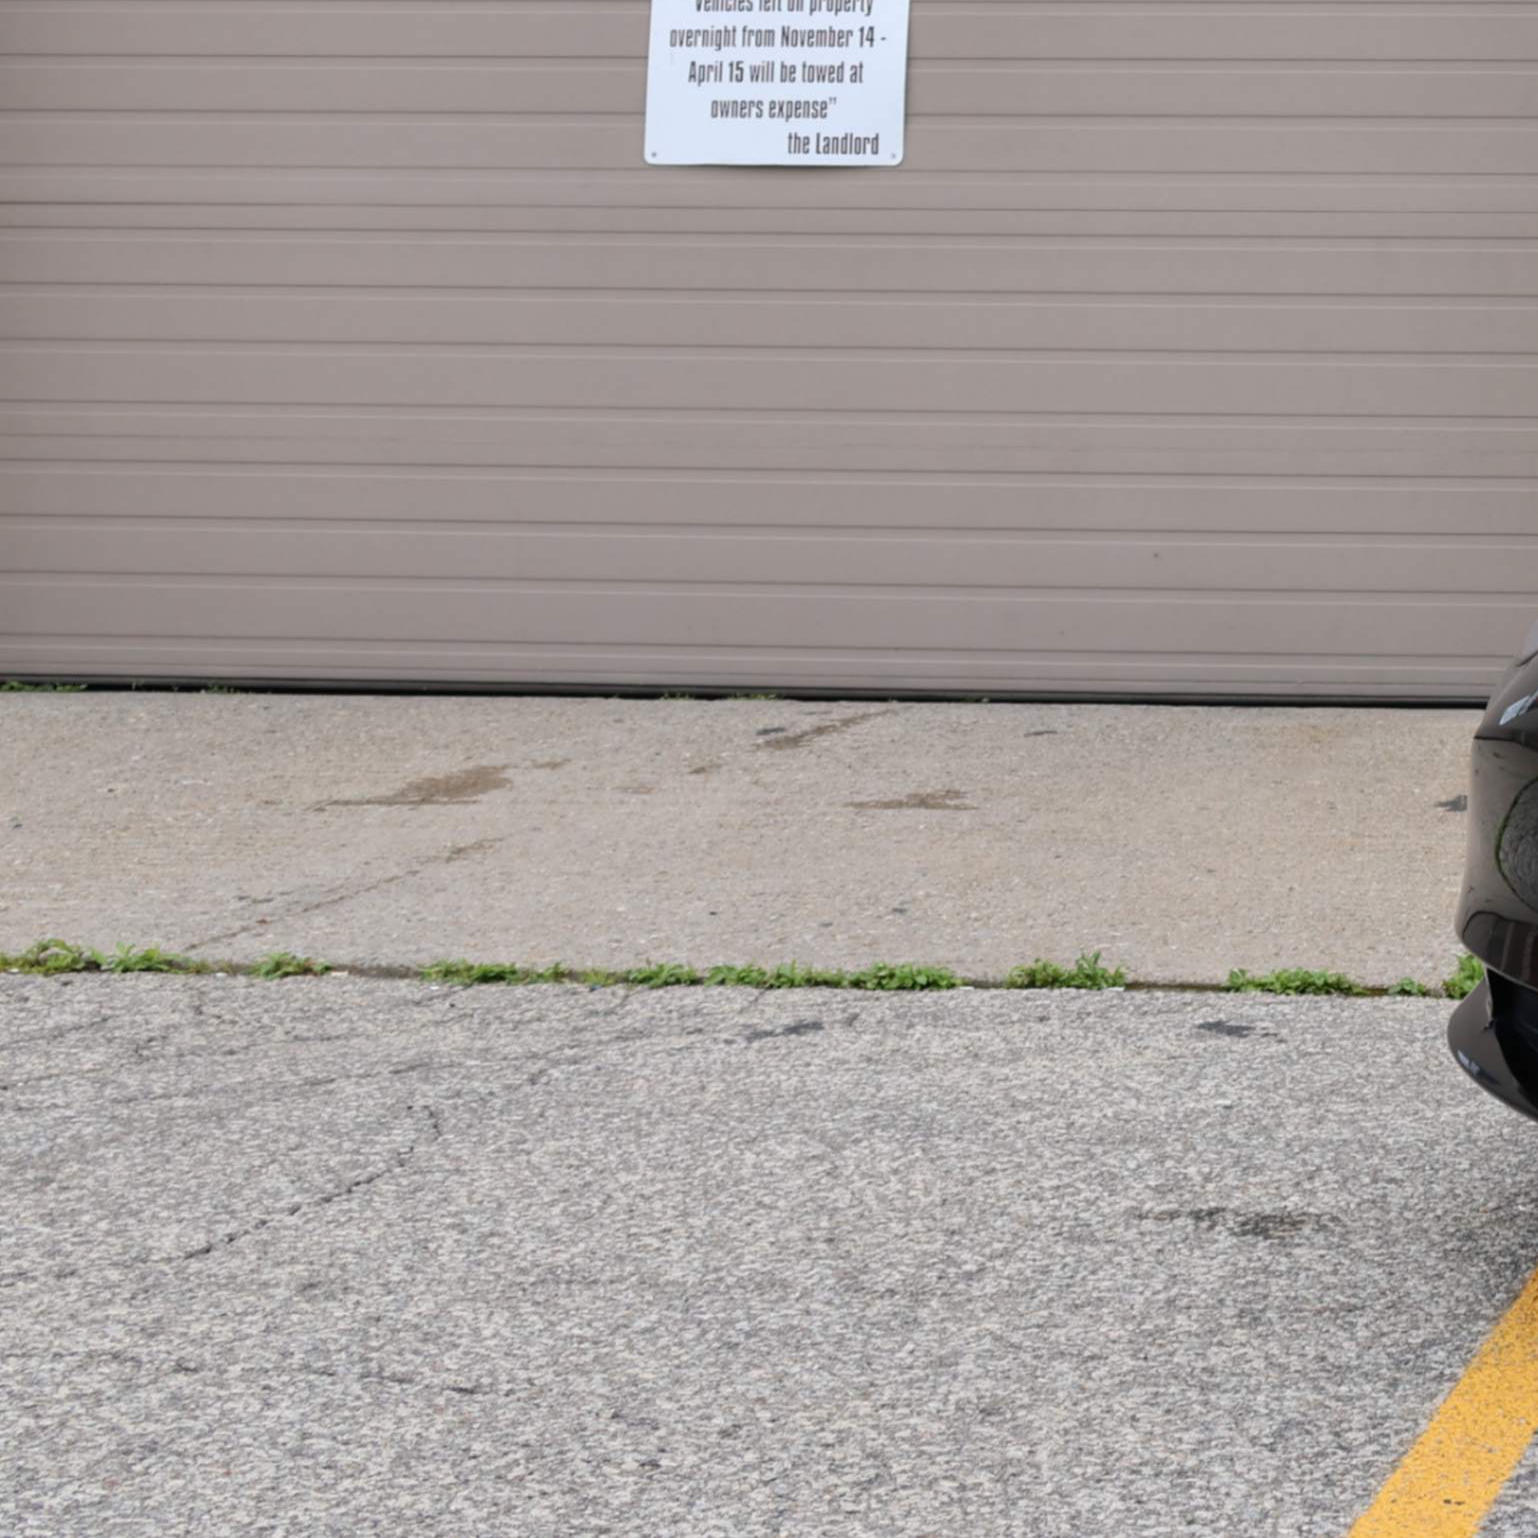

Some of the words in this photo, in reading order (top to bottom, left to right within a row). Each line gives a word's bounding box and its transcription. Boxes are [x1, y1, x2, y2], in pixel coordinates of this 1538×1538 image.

[670, 25, 737, 51] overnight
[742, 25, 775, 48] from
[780, 25, 853, 48] November
[858, 25, 875, 48] 14
[688, 60, 723, 87] April
[728, 60, 744, 83] 15
[749, 61, 775, 83] will
[780, 61, 797, 83] be
[802, 61, 845, 83] towed
[849, 62, 864, 83] at
[711, 99, 764, 119] owners
[787, 132, 810, 155] the
[815, 132, 879, 155] Landlord
